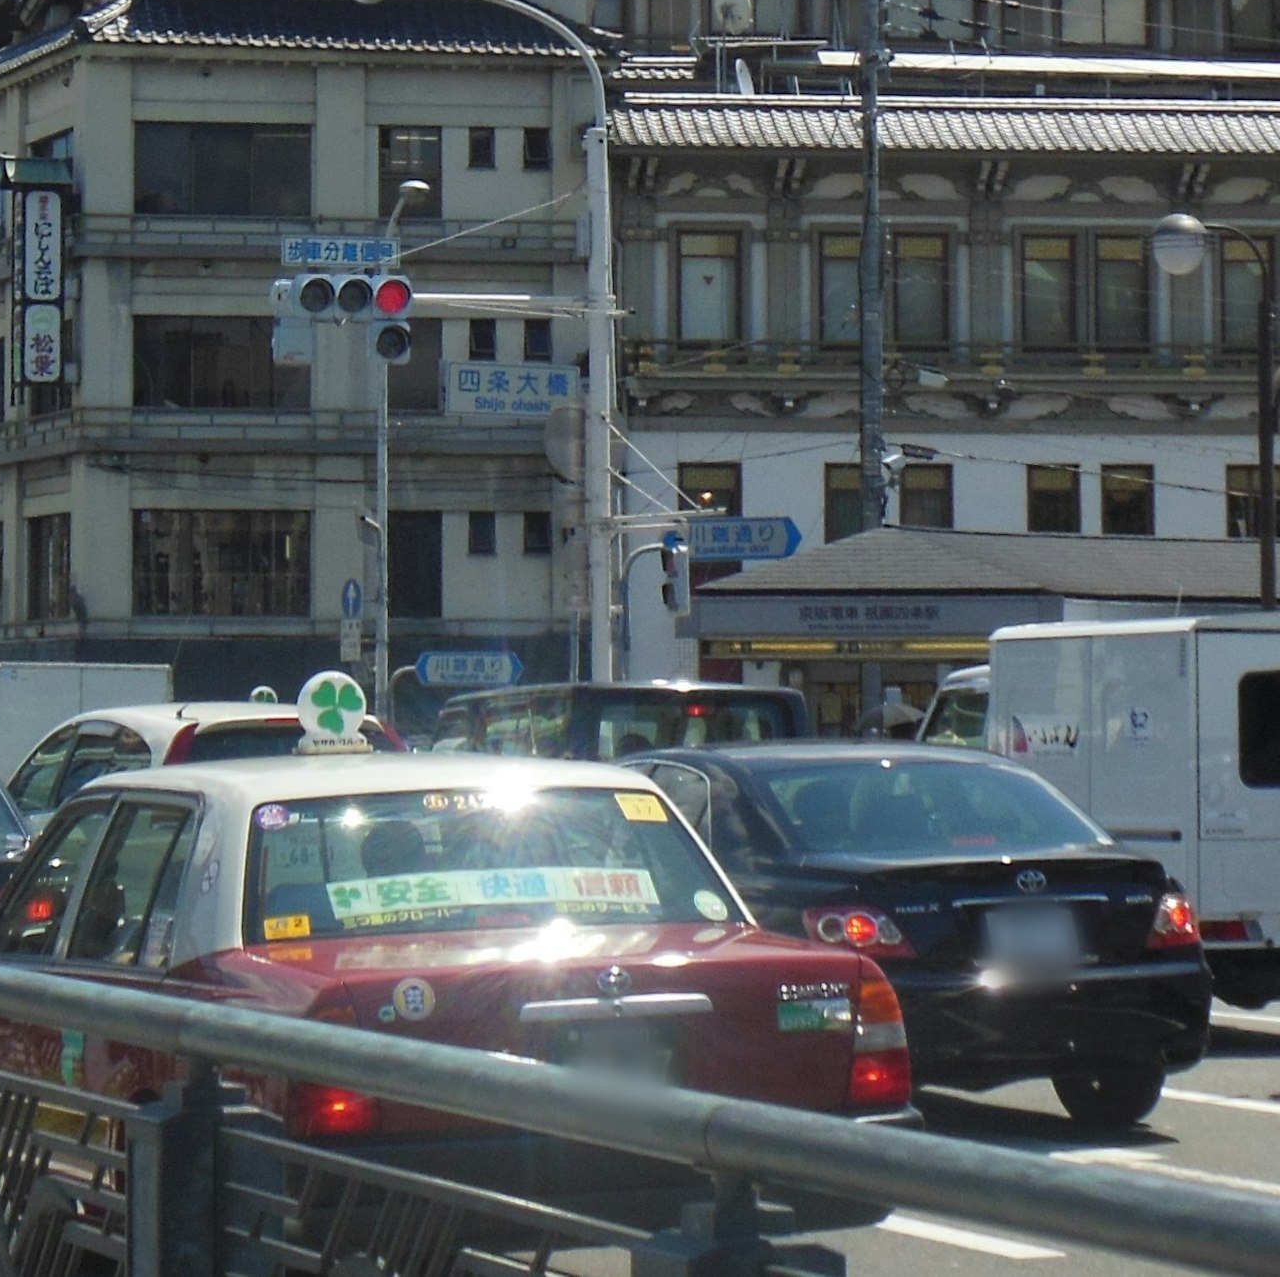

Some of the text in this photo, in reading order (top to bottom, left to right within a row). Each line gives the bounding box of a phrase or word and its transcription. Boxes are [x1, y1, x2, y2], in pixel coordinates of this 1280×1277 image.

[288, 240, 395, 263] 歩車分離信号
[30, 332, 56, 377] 松葉
[458, 369, 568, 397] 四条大橋
[474, 396, 551, 412] Shijo ohashi
[688, 523, 774, 543] 川端通り
[377, 871, 644, 908] 安全 快適 信頼
